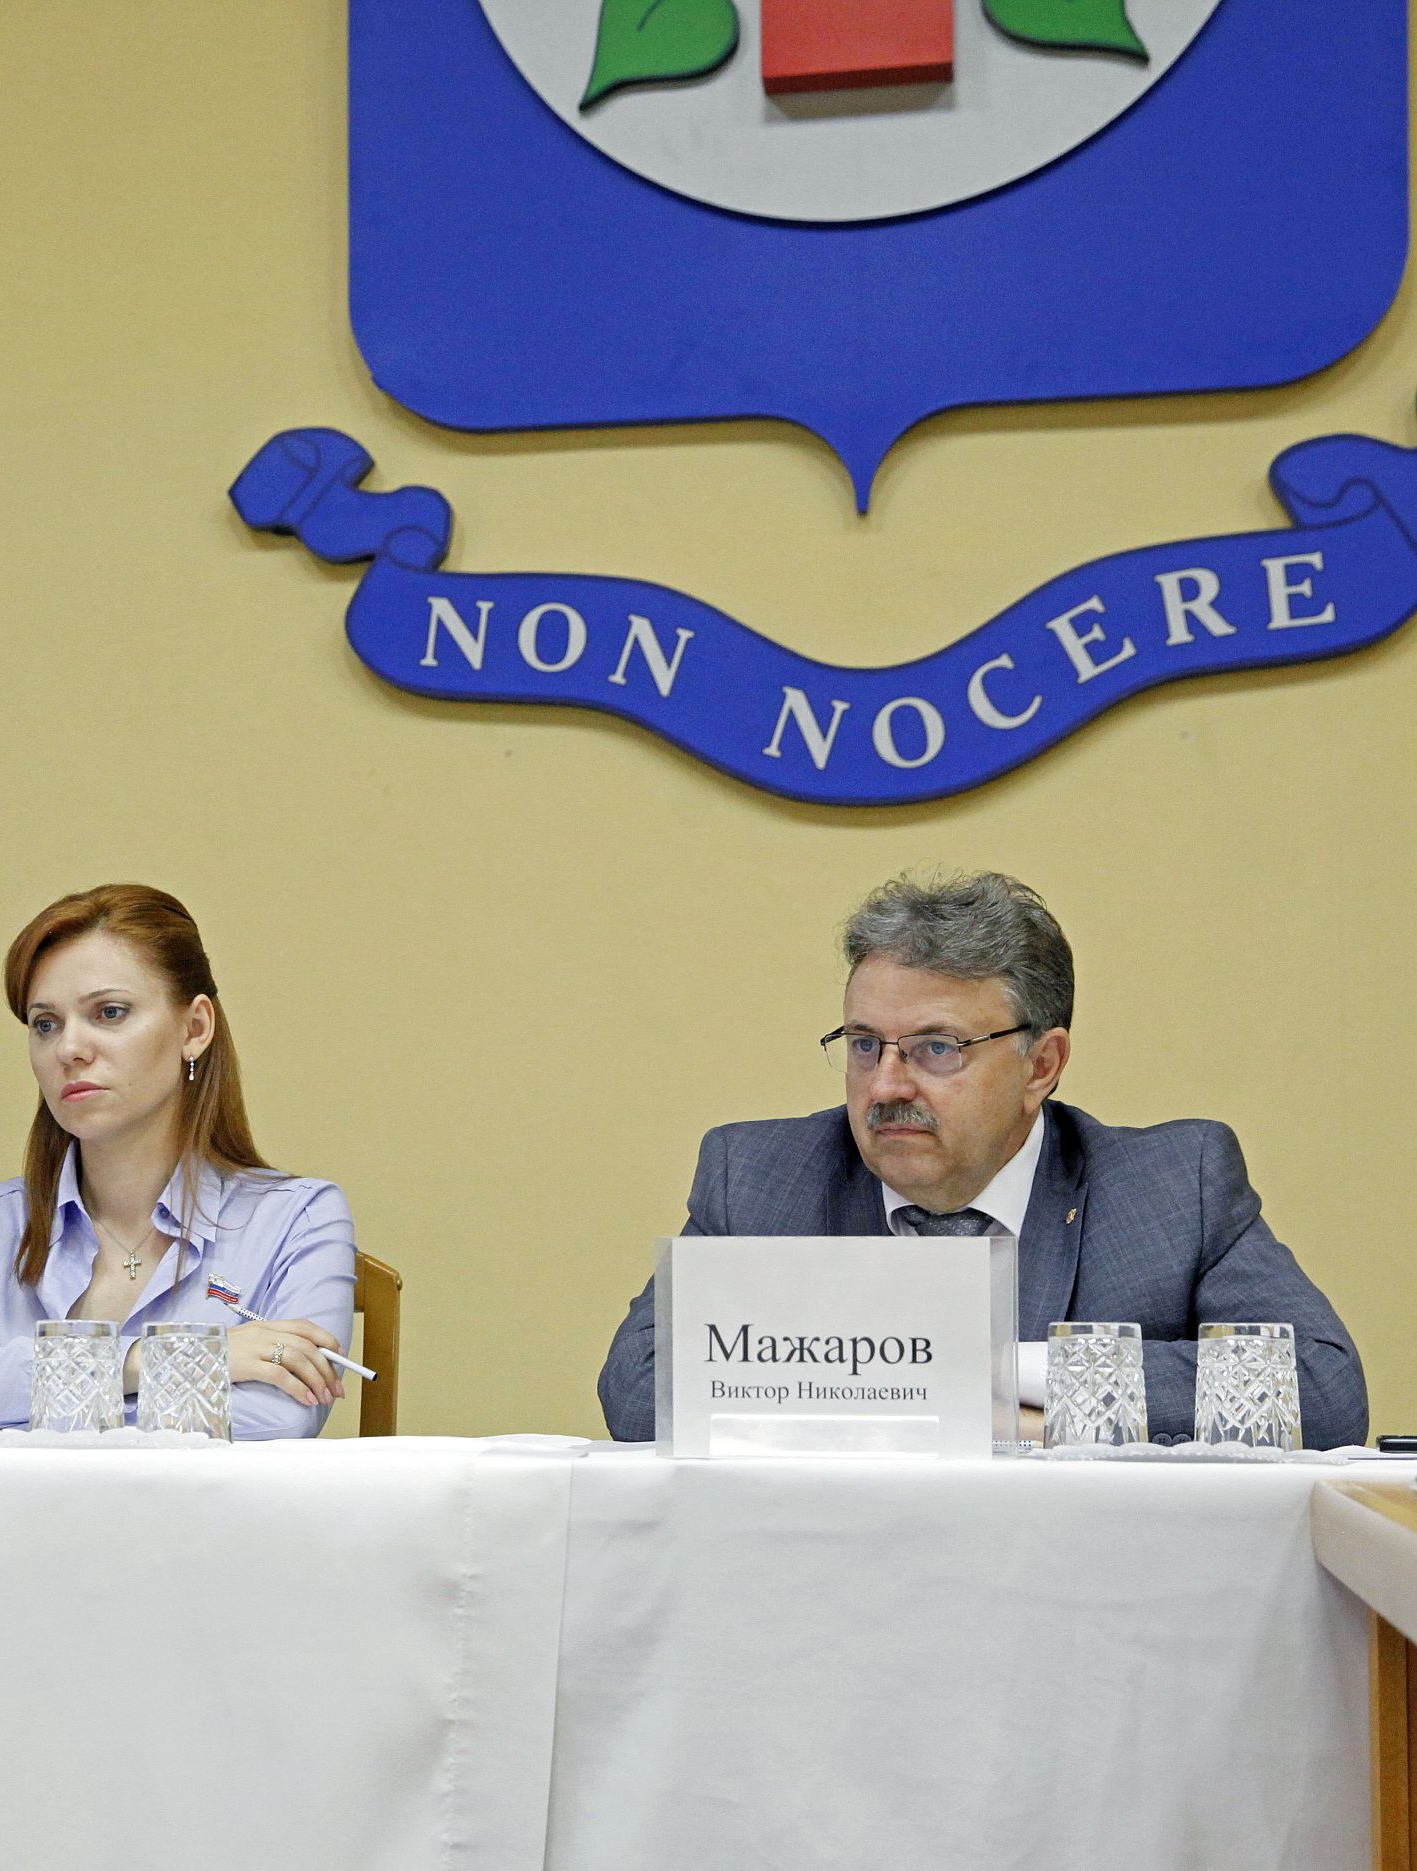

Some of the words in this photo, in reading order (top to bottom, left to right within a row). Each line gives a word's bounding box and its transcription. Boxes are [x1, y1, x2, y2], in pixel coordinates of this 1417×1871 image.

[420, 596, 694, 697] NON
[763, 552, 1337, 770] NOCERE
[704, 1323, 933, 1376] Мажаров
[710, 1379, 790, 1404] Виктор
[797, 1380, 928, 1401] Николаевич
